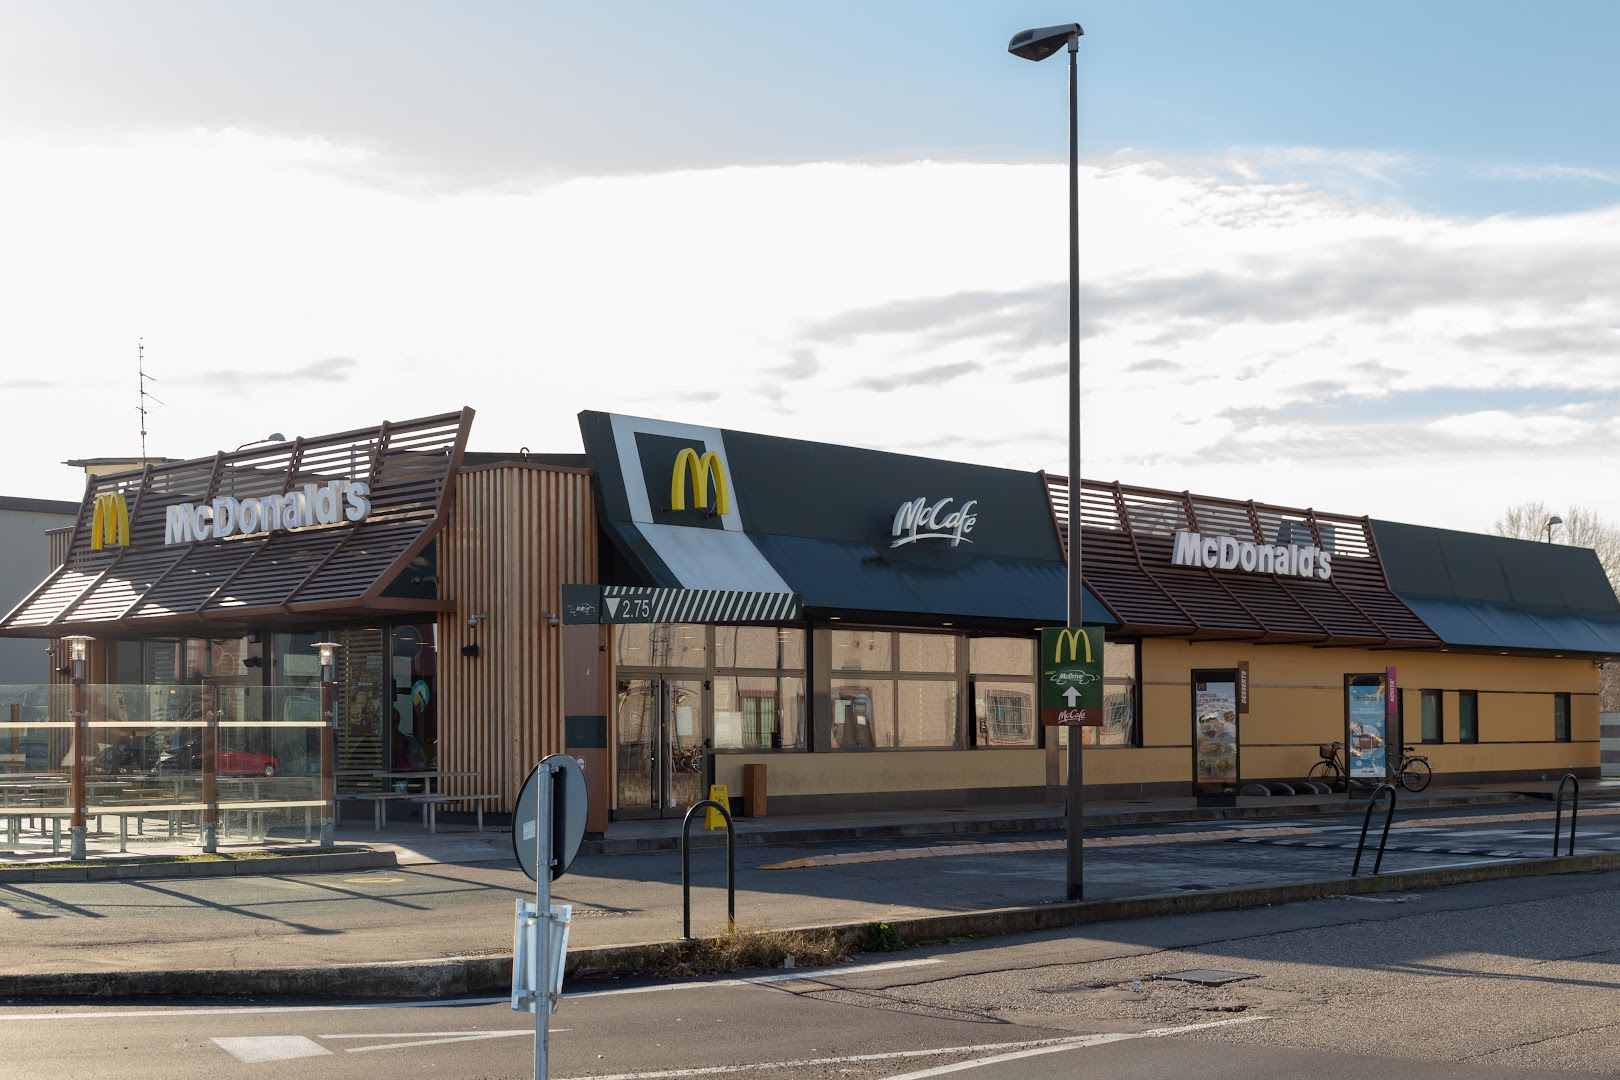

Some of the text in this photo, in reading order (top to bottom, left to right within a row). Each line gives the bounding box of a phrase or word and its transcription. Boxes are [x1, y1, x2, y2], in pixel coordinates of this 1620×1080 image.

[164, 479, 372, 545] McDonald's
[890, 496, 978, 547] McCafé
[1171, 531, 1332, 580] McDonald's
[622, 599, 650, 618] 2.75
[1058, 672, 1085, 681] McDrive
[1058, 709, 1086, 724] McCafé
